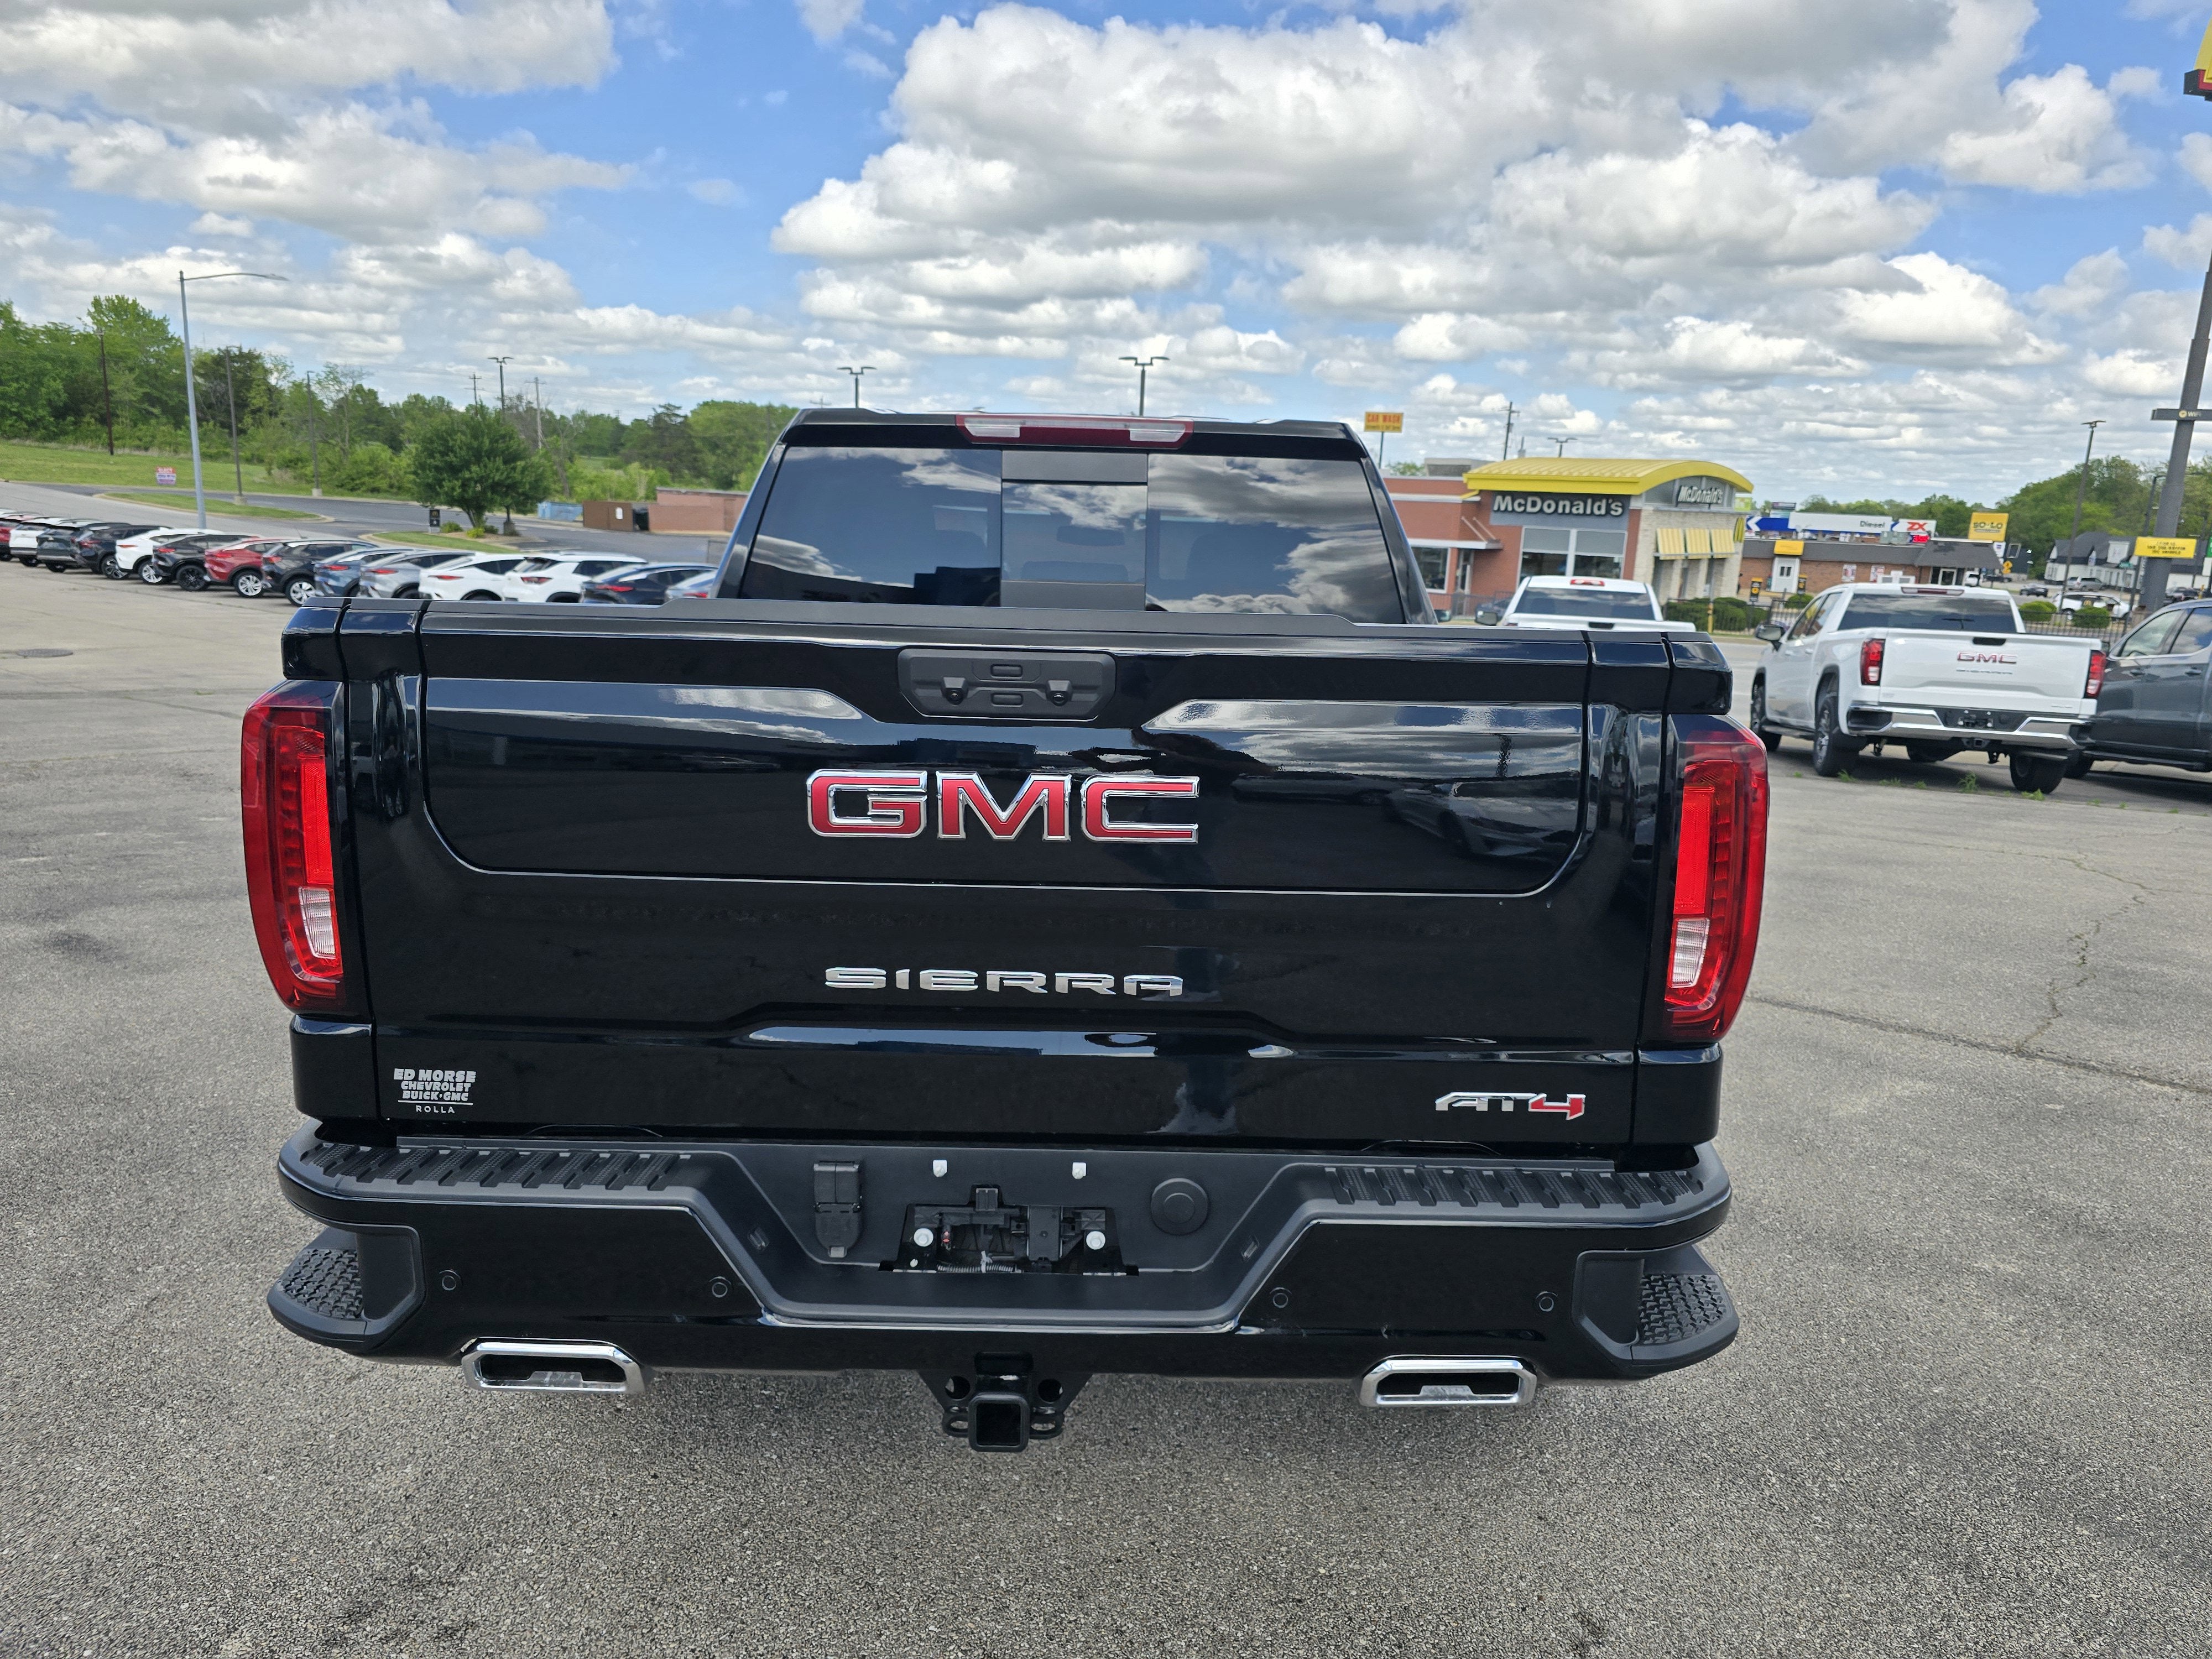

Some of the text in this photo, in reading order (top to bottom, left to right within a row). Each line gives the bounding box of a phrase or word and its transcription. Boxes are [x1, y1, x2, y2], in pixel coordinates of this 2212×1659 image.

[1677, 486, 1724, 504] McDonald's
[1493, 495, 1624, 517] McDonald's
[1860, 520, 1885, 529] Diesel
[1907, 521, 1928, 531] ZX
[1957, 650, 2017, 664] GMC
[806, 768, 1200, 844] GMC
[825, 967, 1183, 997] SIERRA
[393, 1068, 477, 1083] ED MORSE
[400, 1081, 471, 1092] CHEVROLET
[416, 1105, 455, 1114] ROLLA
[1434, 1092, 1586, 1120] AT4
